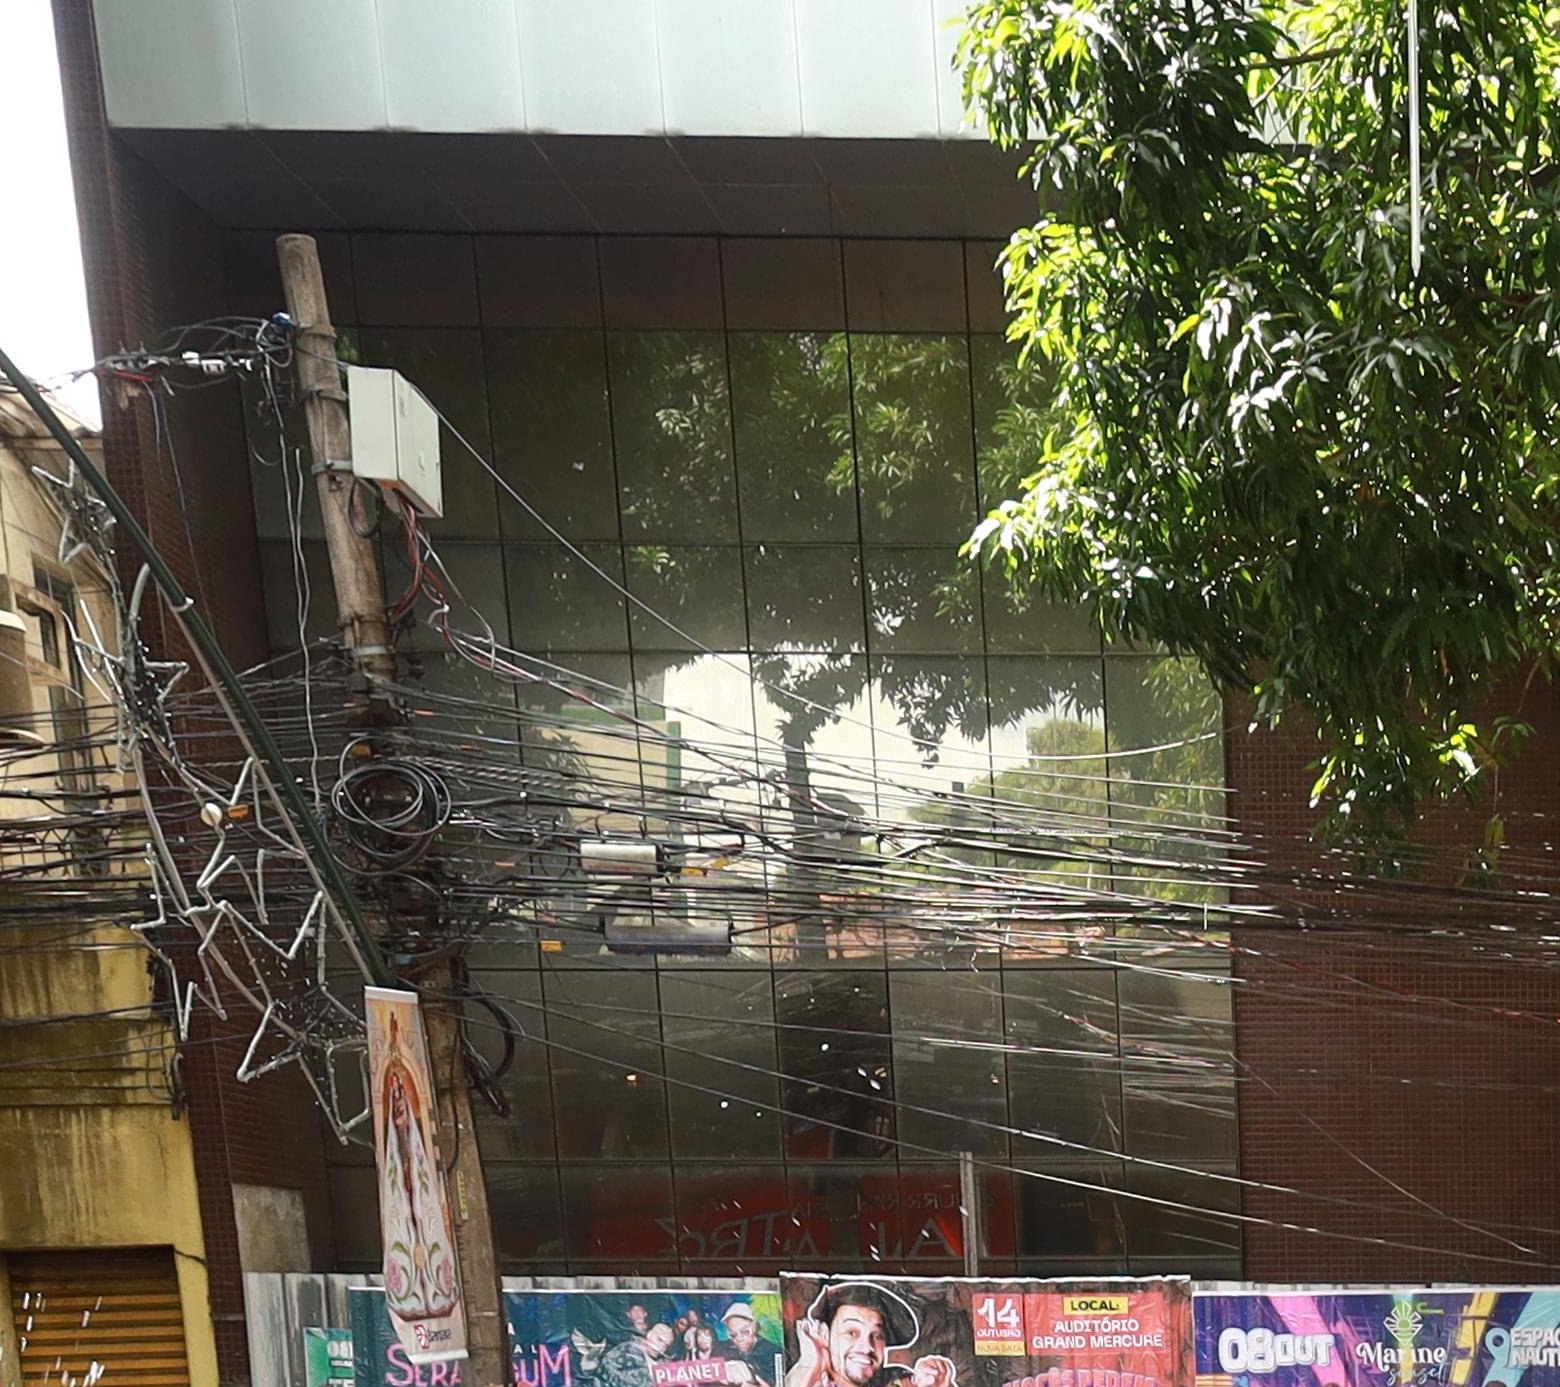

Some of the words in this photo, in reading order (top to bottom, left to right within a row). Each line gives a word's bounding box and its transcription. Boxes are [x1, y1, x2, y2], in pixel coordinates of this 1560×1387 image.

[977, 1298, 1021, 1328] 14
[976, 1327, 1022, 1338] OUTUBRO
[1054, 1317, 1140, 1333] AUDITÓRIO
[1032, 1335, 1087, 1349] GRAND
[1090, 1334, 1163, 1348] MERCURE
[654, 1362, 722, 1384] PLANET
